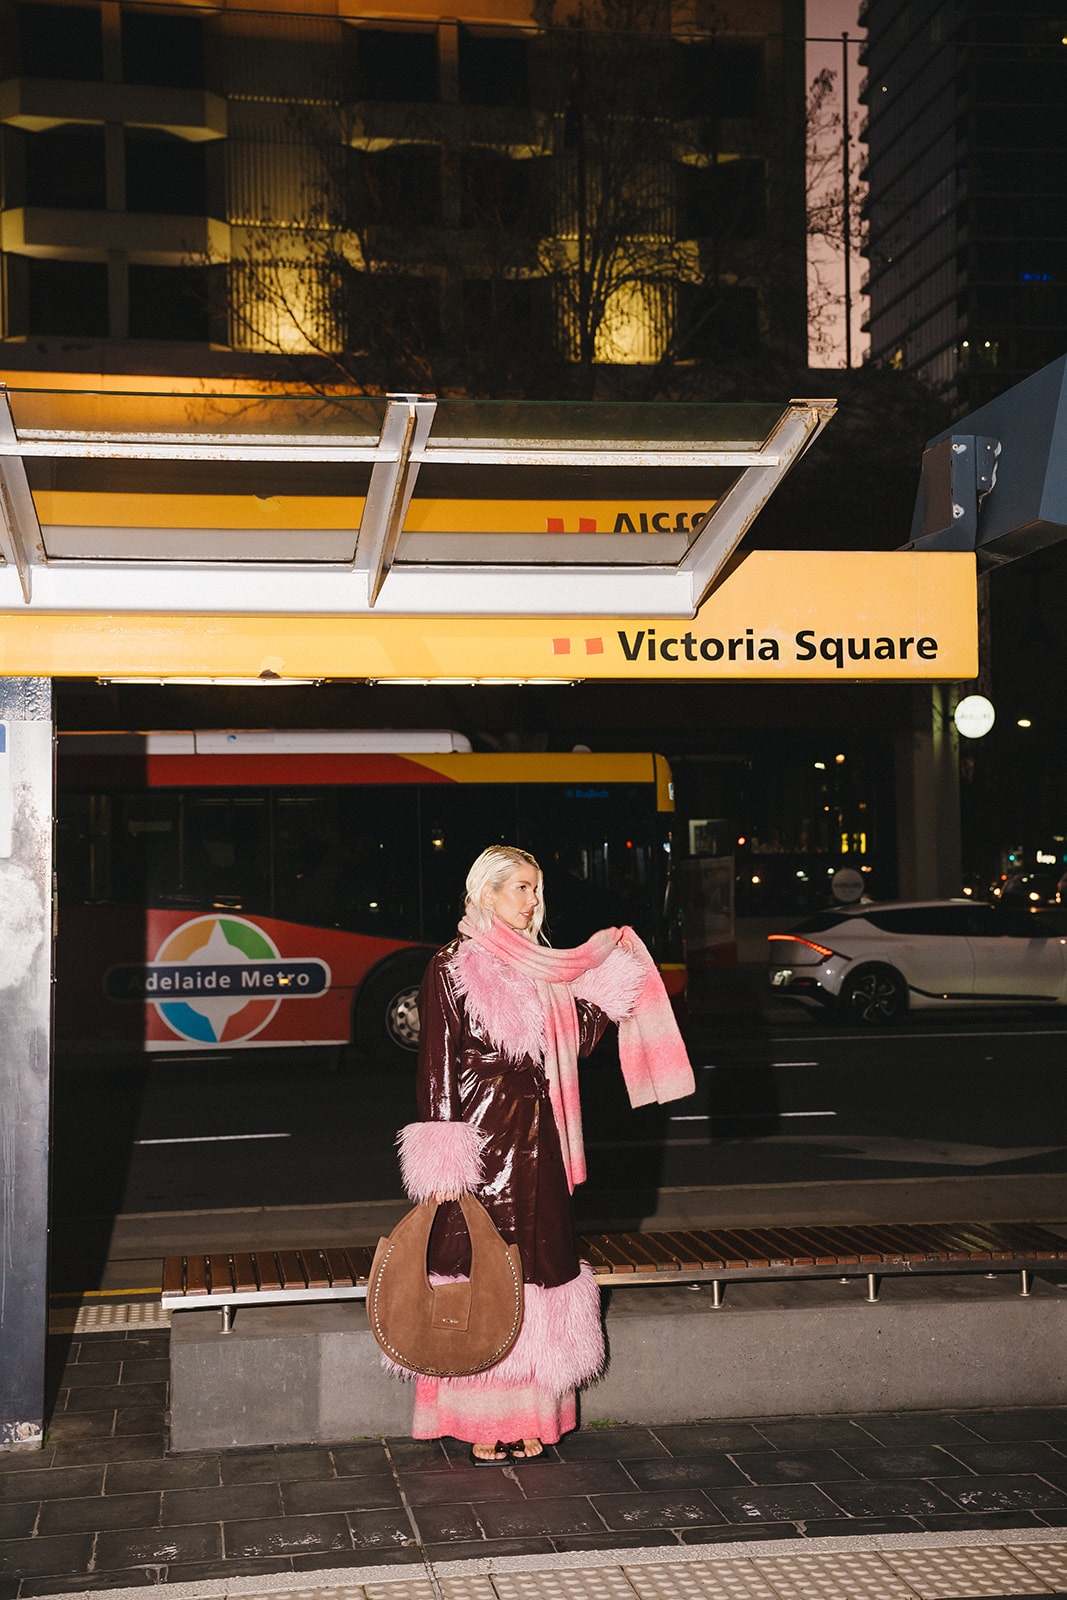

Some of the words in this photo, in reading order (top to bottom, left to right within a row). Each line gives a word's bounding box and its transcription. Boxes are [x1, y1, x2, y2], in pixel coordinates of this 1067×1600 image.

[617, 628, 780, 662] Victoria
[795, 630, 938, 669] Square
[241, 970, 310, 988] Metro
